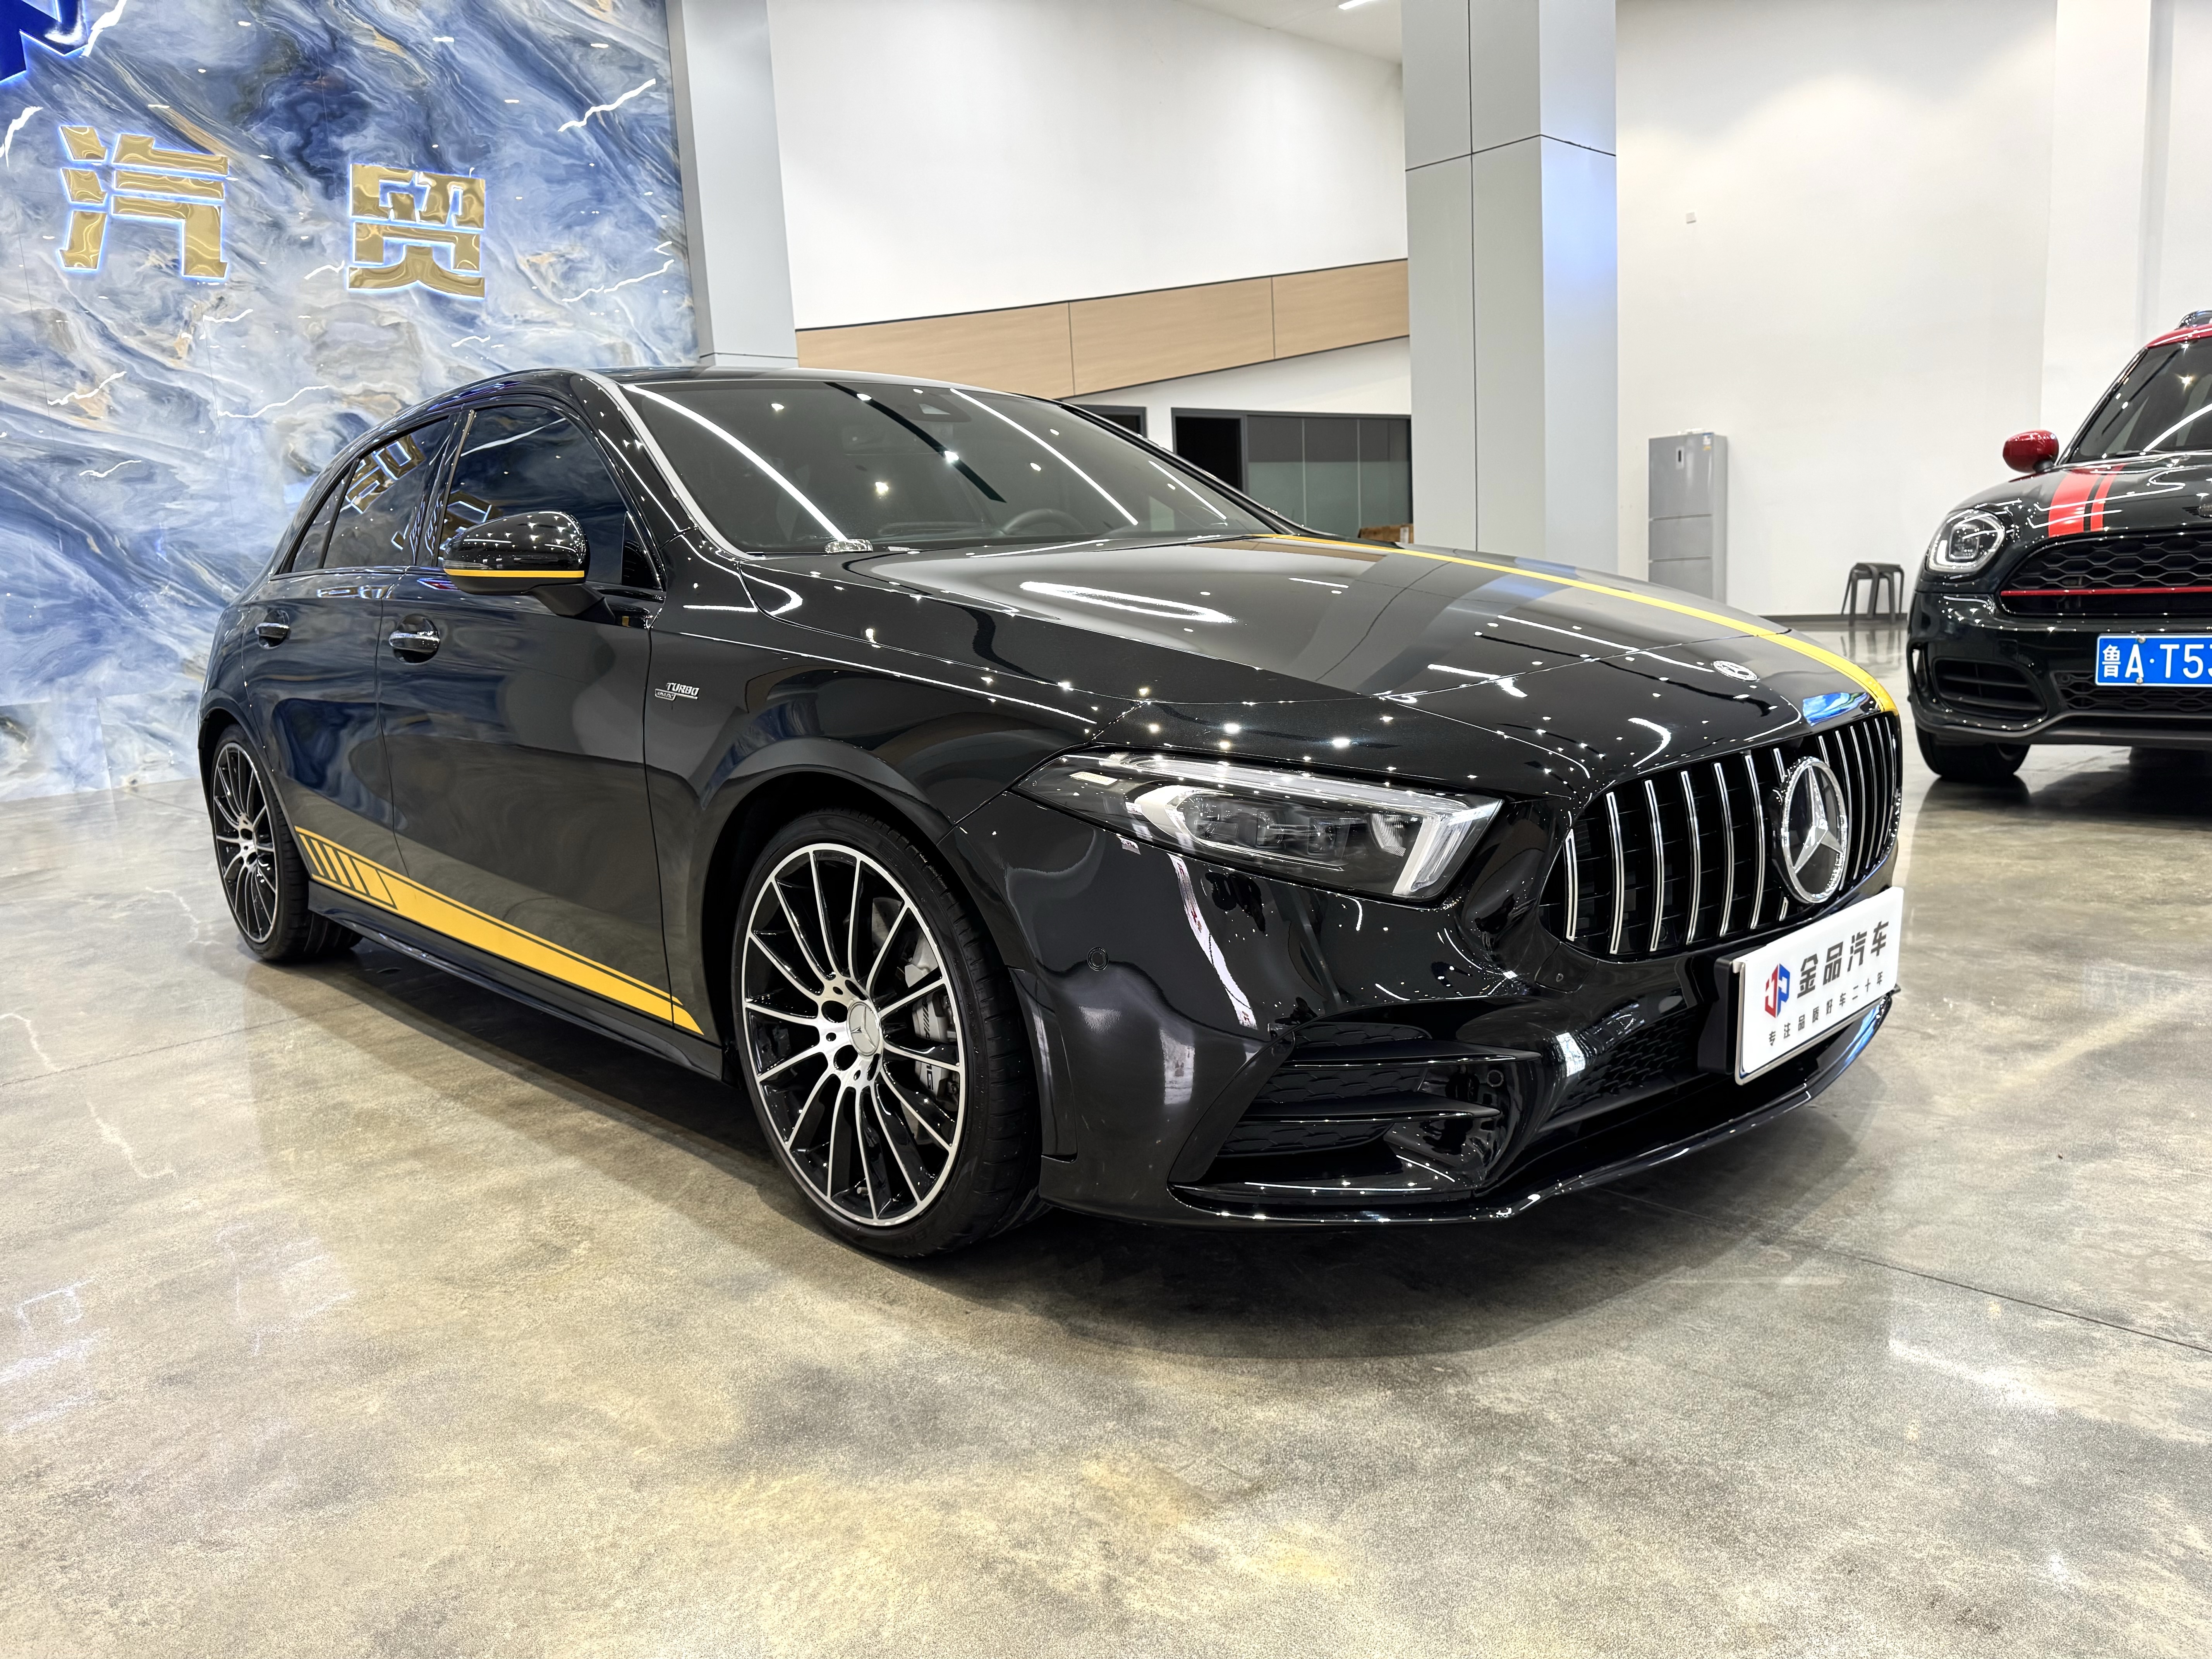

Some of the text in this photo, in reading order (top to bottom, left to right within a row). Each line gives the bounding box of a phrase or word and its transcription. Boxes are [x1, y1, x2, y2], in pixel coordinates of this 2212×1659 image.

[58, 125, 486, 300] 汽贸
[666, 682, 700, 696] TURBO
[2102, 644, 2212, 678] 鲁A·T5
[1796, 921, 1889, 999] 金品汽车
[1768, 971, 1883, 1046] 专注品质好车二十年
